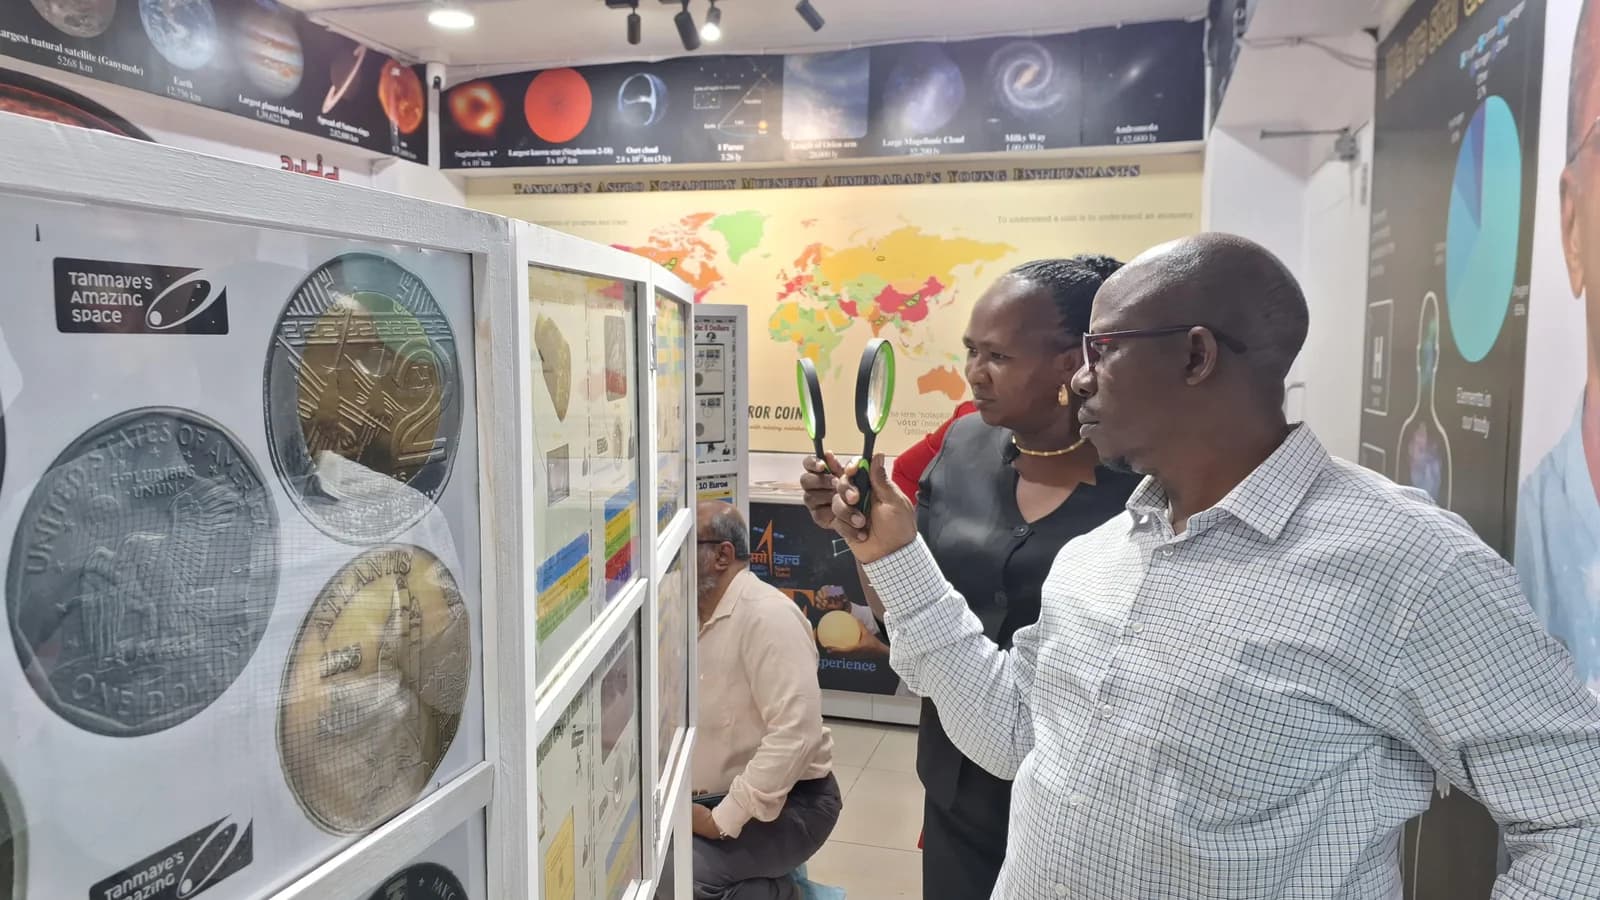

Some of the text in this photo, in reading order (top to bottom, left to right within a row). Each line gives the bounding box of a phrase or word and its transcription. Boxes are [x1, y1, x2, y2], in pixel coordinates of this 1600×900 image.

[0, 29, 144, 77] argest natural satellite (Ganymede)
[79, 61, 94, 73] km
[1114, 122, 1159, 135] Andromeda
[882, 137, 903, 148] Large
[943, 134, 965, 144] Cloud
[1005, 132, 1046, 144] Milky Way
[947, 170, 1007, 184] YOUNG
[1013, 165, 1141, 181] ENTHUSIASTS
[68, 271, 153, 293] Tanmaye's
[72, 309, 122, 323] space
[748, 405, 771, 419] ROR
[699, 480, 729, 490] 10 Euros
[315, 550, 415, 641] ATLANTIS
[818, 657, 876, 672] perience
